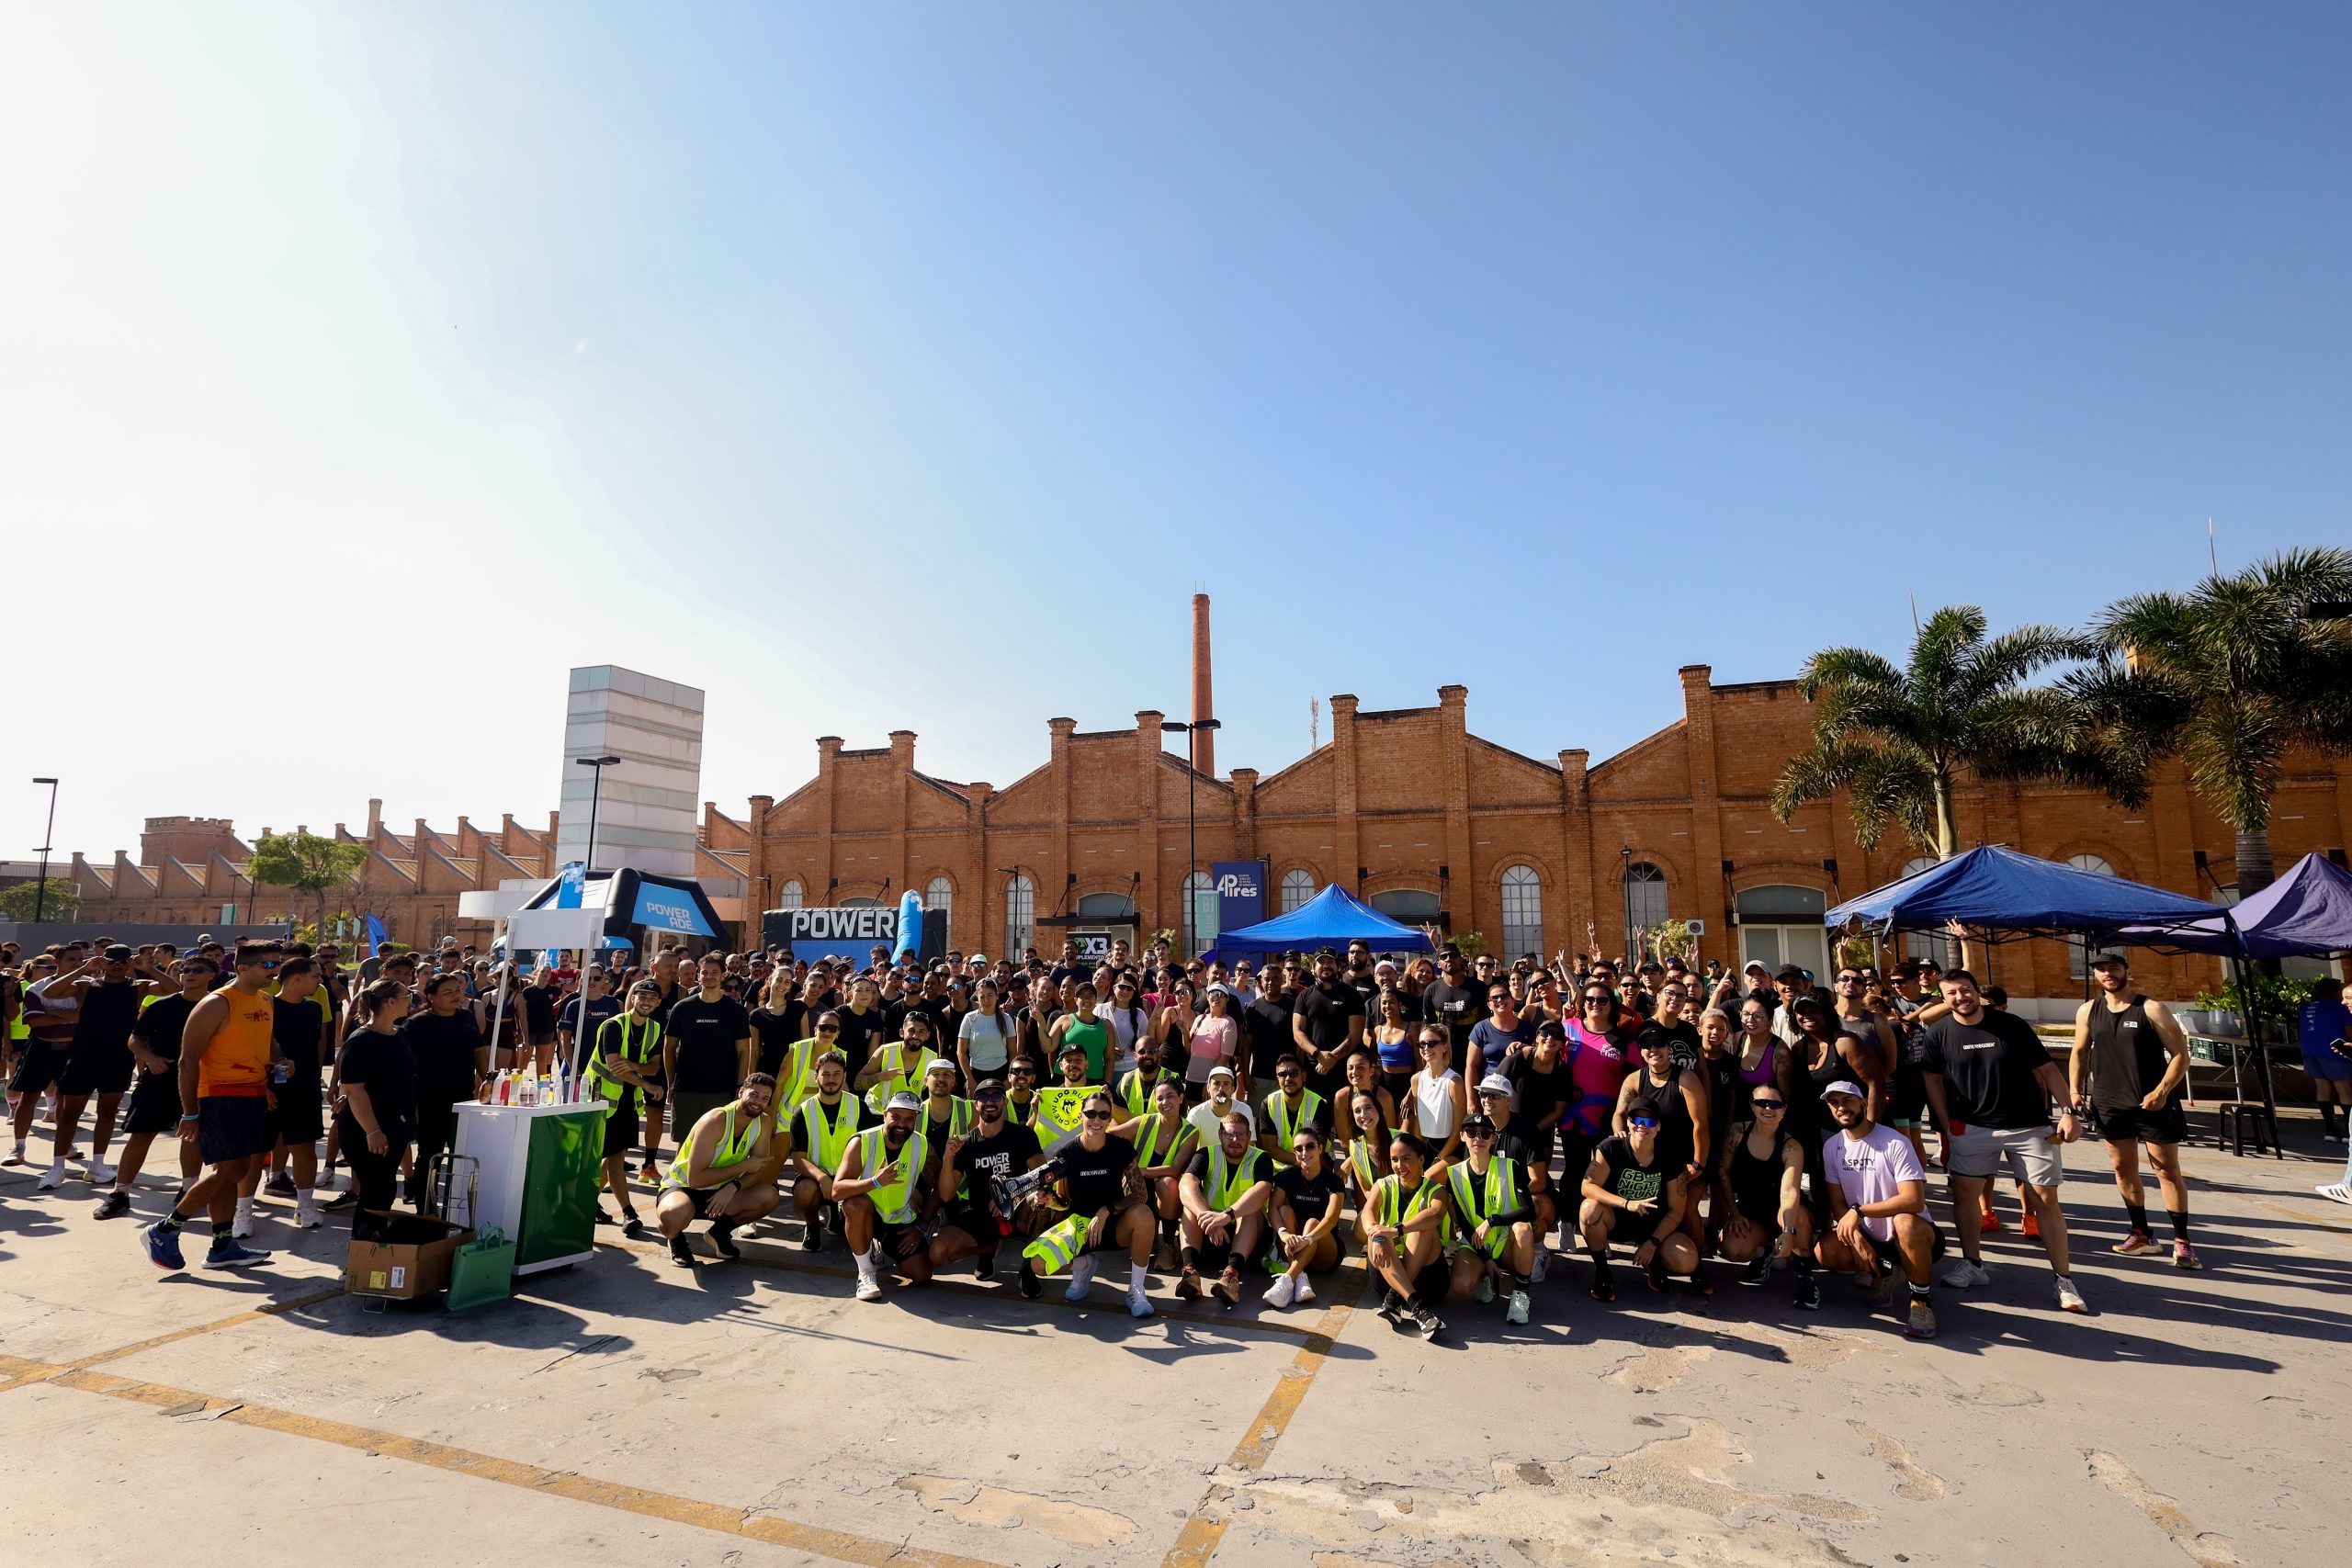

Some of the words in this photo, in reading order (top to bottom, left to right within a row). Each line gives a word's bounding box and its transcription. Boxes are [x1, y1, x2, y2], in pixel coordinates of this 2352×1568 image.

[646, 901, 691, 920] POWER
[669, 917, 695, 931] ADE
[791, 909, 895, 939] POWER
[975, 1152, 1010, 1169] POWER
